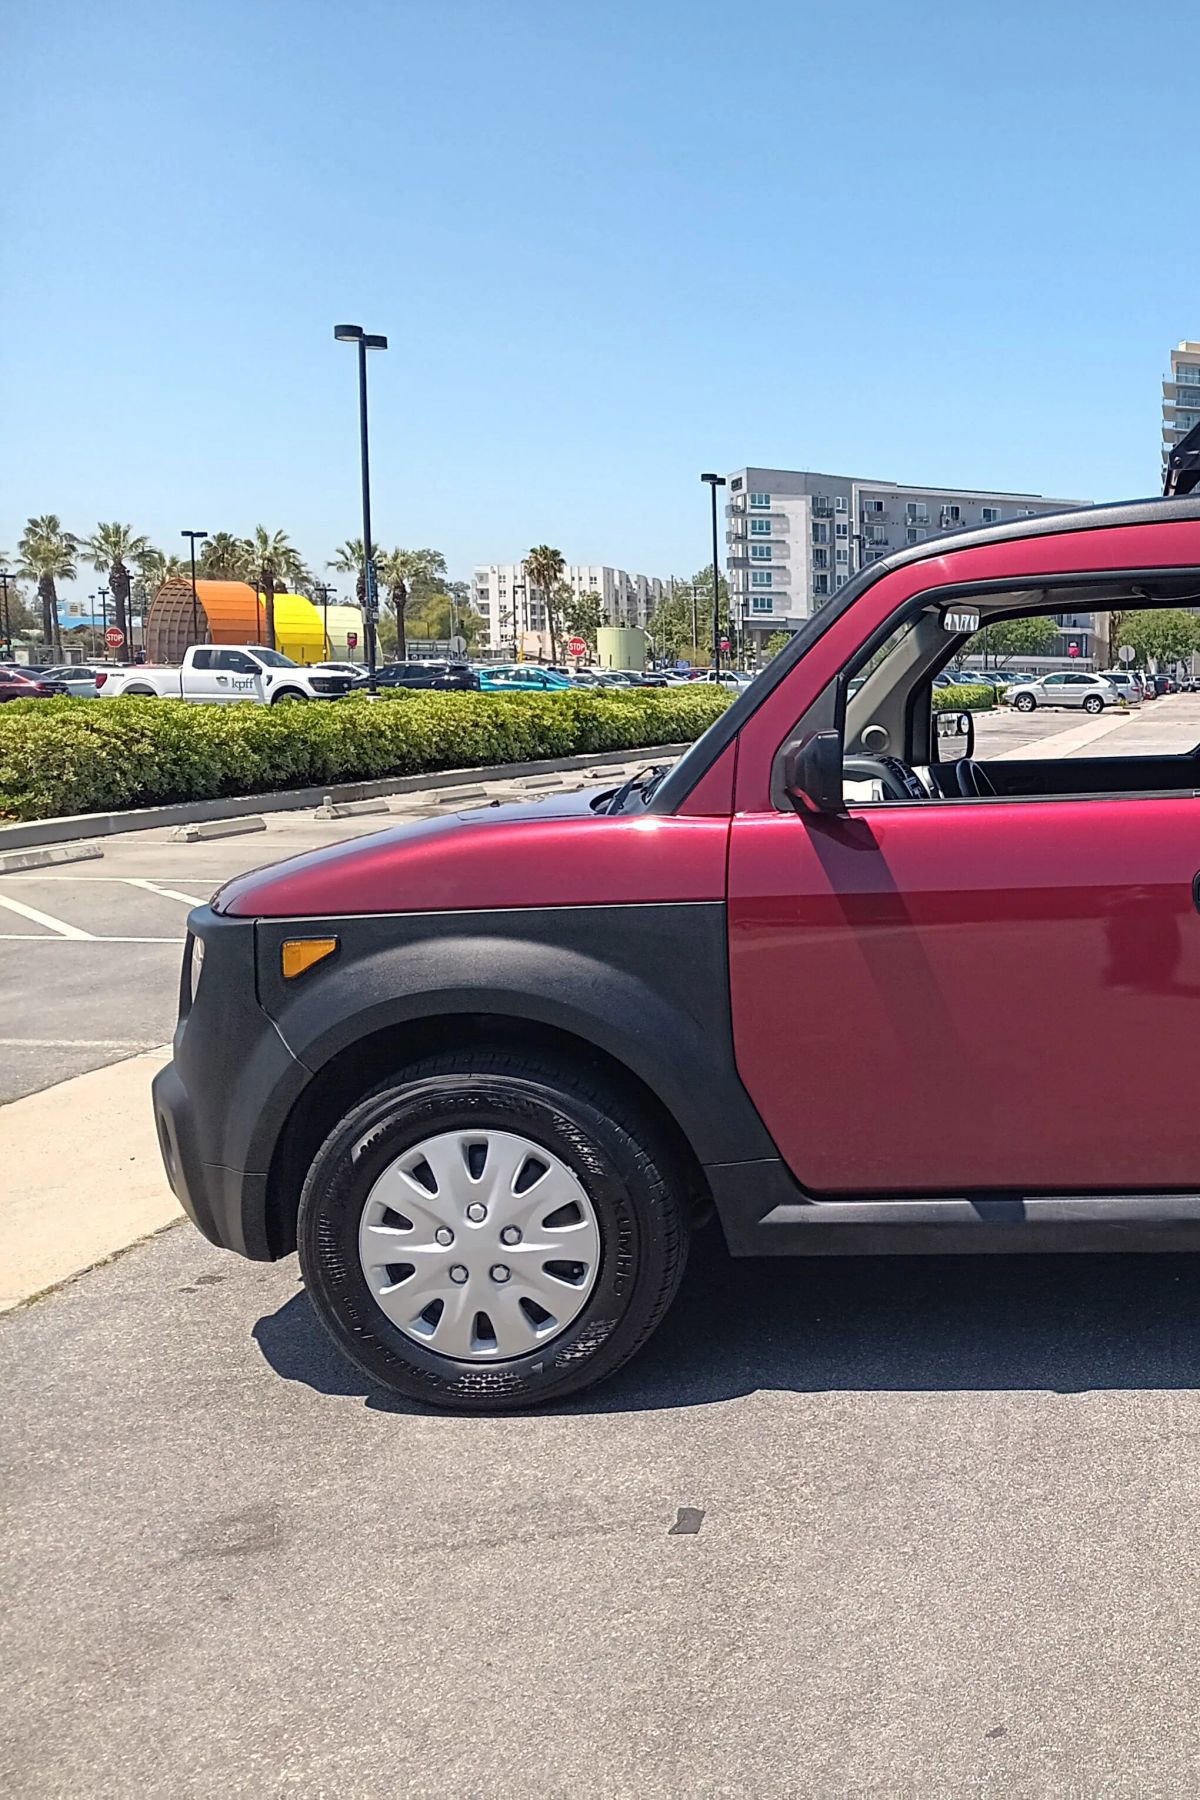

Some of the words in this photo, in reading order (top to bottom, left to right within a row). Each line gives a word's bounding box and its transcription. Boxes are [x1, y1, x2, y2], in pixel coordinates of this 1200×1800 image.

[106, 633, 123, 642] STOP
[569, 642, 585, 651] STOP
[231, 677, 254, 691] kpff
